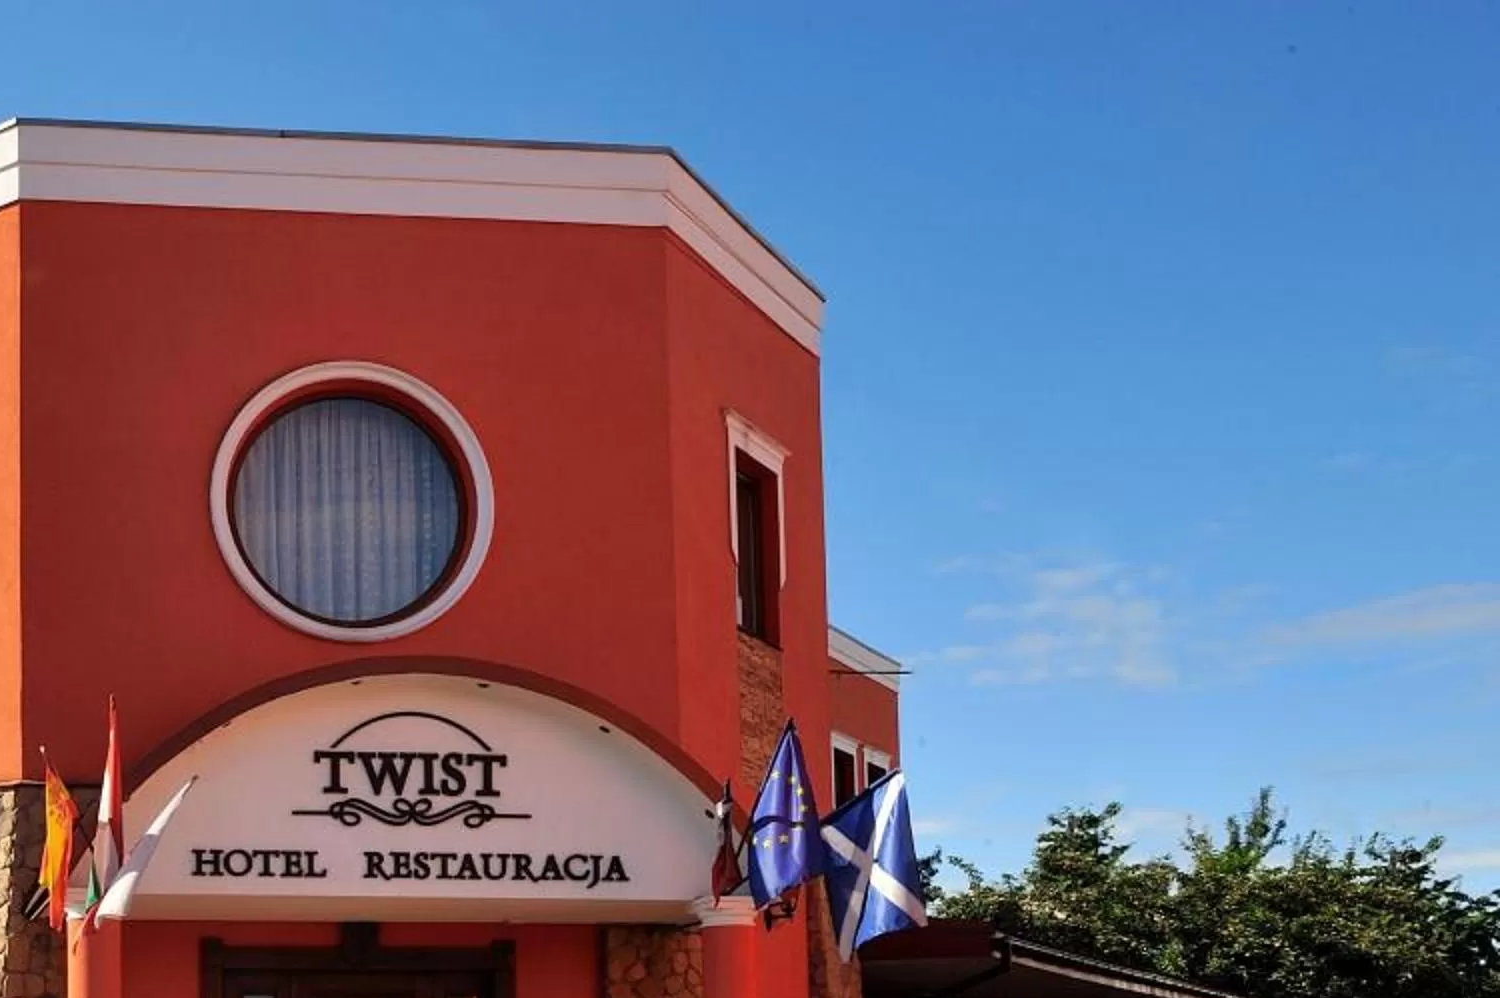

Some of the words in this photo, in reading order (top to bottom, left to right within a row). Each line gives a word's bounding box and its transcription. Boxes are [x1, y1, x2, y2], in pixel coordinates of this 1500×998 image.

[313, 750, 508, 798] TWIST
[191, 848, 328, 879] HOTEL
[362, 850, 630, 889] RESTAURACJA
